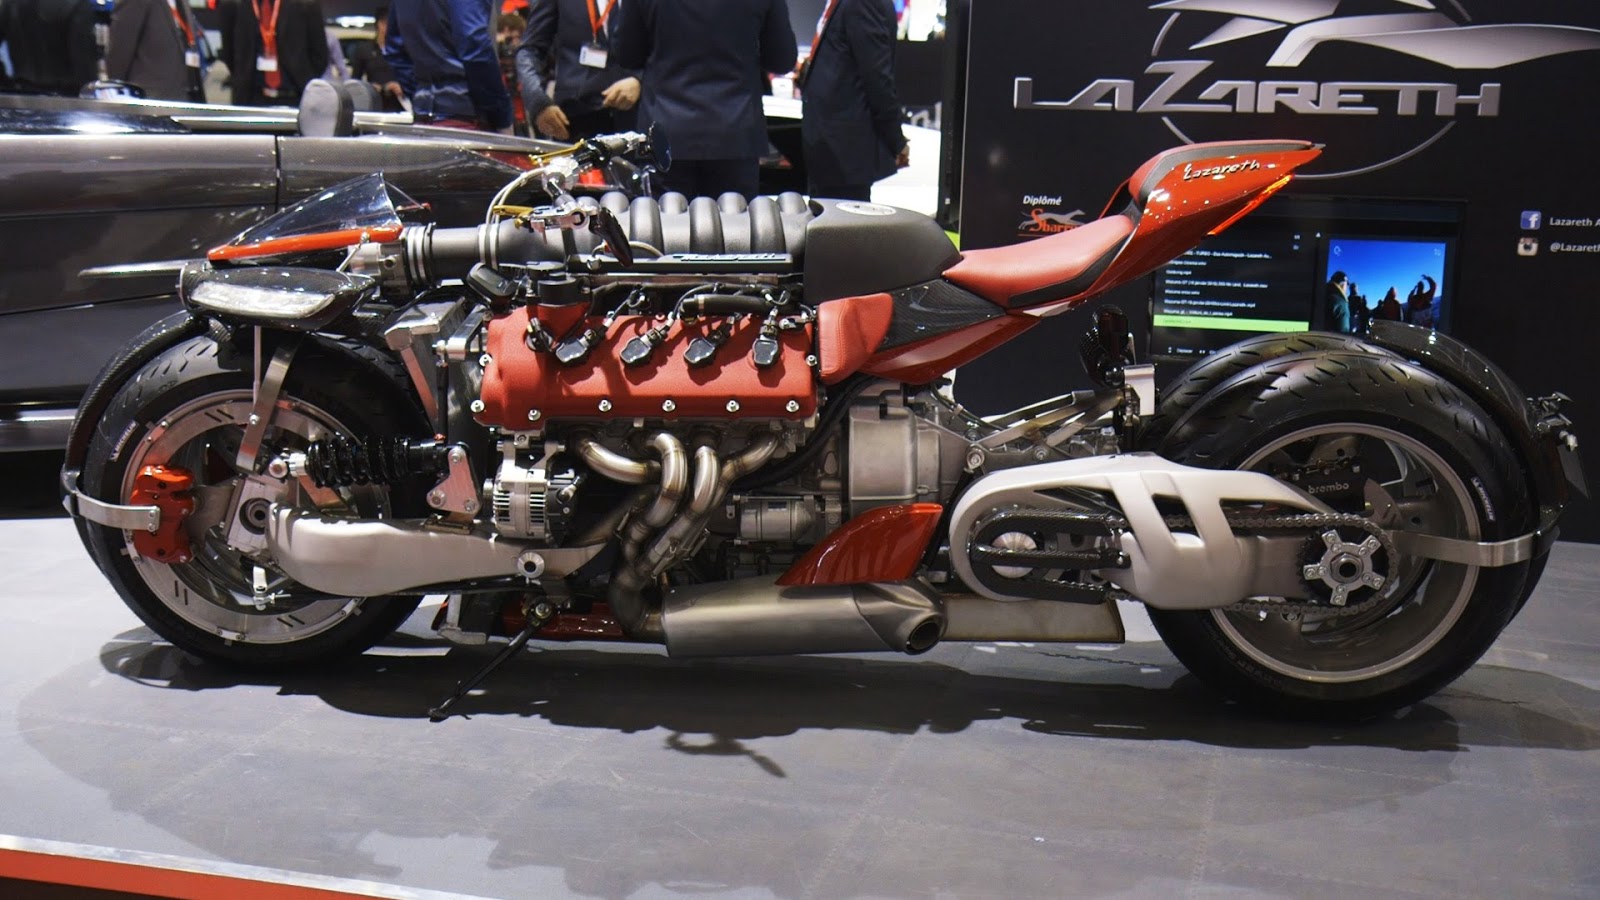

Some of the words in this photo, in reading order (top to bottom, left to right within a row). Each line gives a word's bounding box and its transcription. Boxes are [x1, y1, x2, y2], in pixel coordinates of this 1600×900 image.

[1014, 60, 1501, 117] LAZARETH
[1183, 160, 1260, 180] Lazareth
[1022, 194, 1062, 206] Diplômé
[1549, 217, 1593, 227] Lazareth
[1308, 482, 1350, 494] brembo
